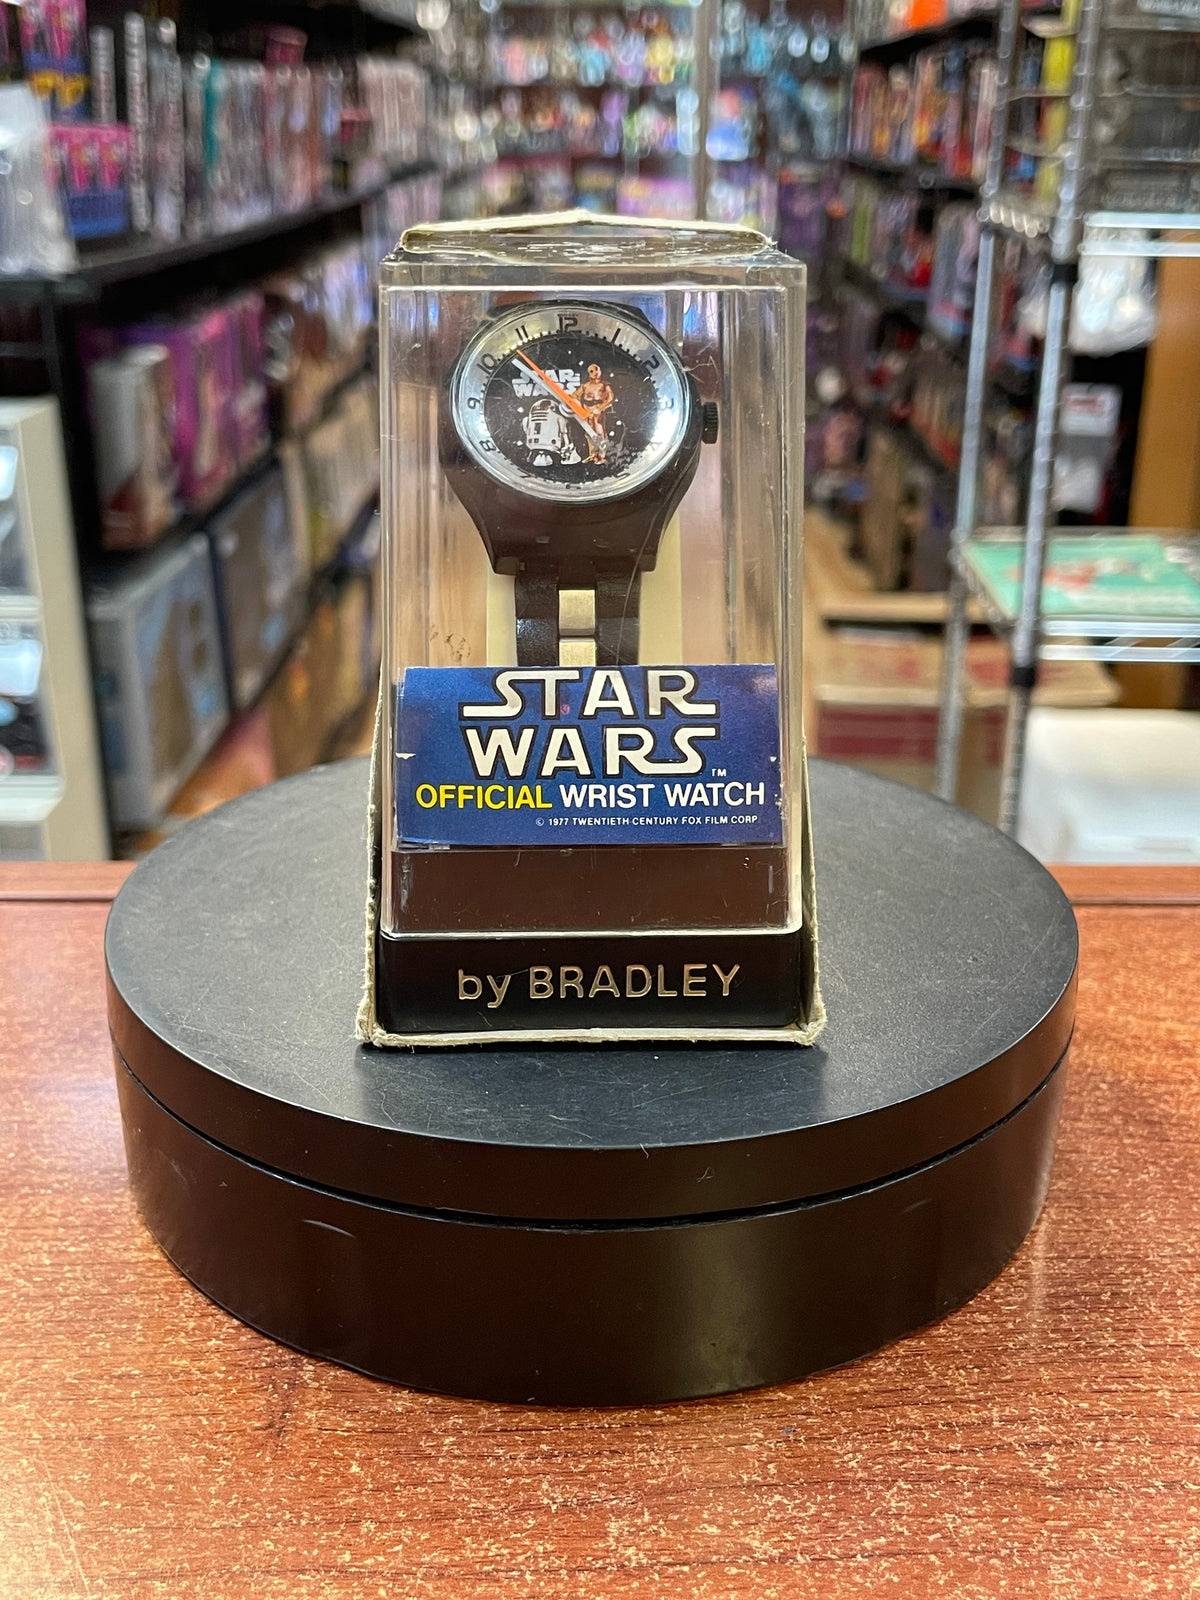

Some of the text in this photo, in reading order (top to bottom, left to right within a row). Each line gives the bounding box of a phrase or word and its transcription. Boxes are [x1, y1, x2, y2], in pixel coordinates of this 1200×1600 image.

[559, 316, 581, 334] 12
[477, 353, 498, 374] 10
[460, 668, 719, 719] STAR
[461, 723, 719, 779] WARS
[415, 781, 765, 809] OFFICIAL WRIST WATCH
[548, 816, 569, 826] 1977
[681, 816, 702, 825] FOX
[704, 816, 728, 824] FILM
[457, 963, 741, 1009] by BRADLEY
